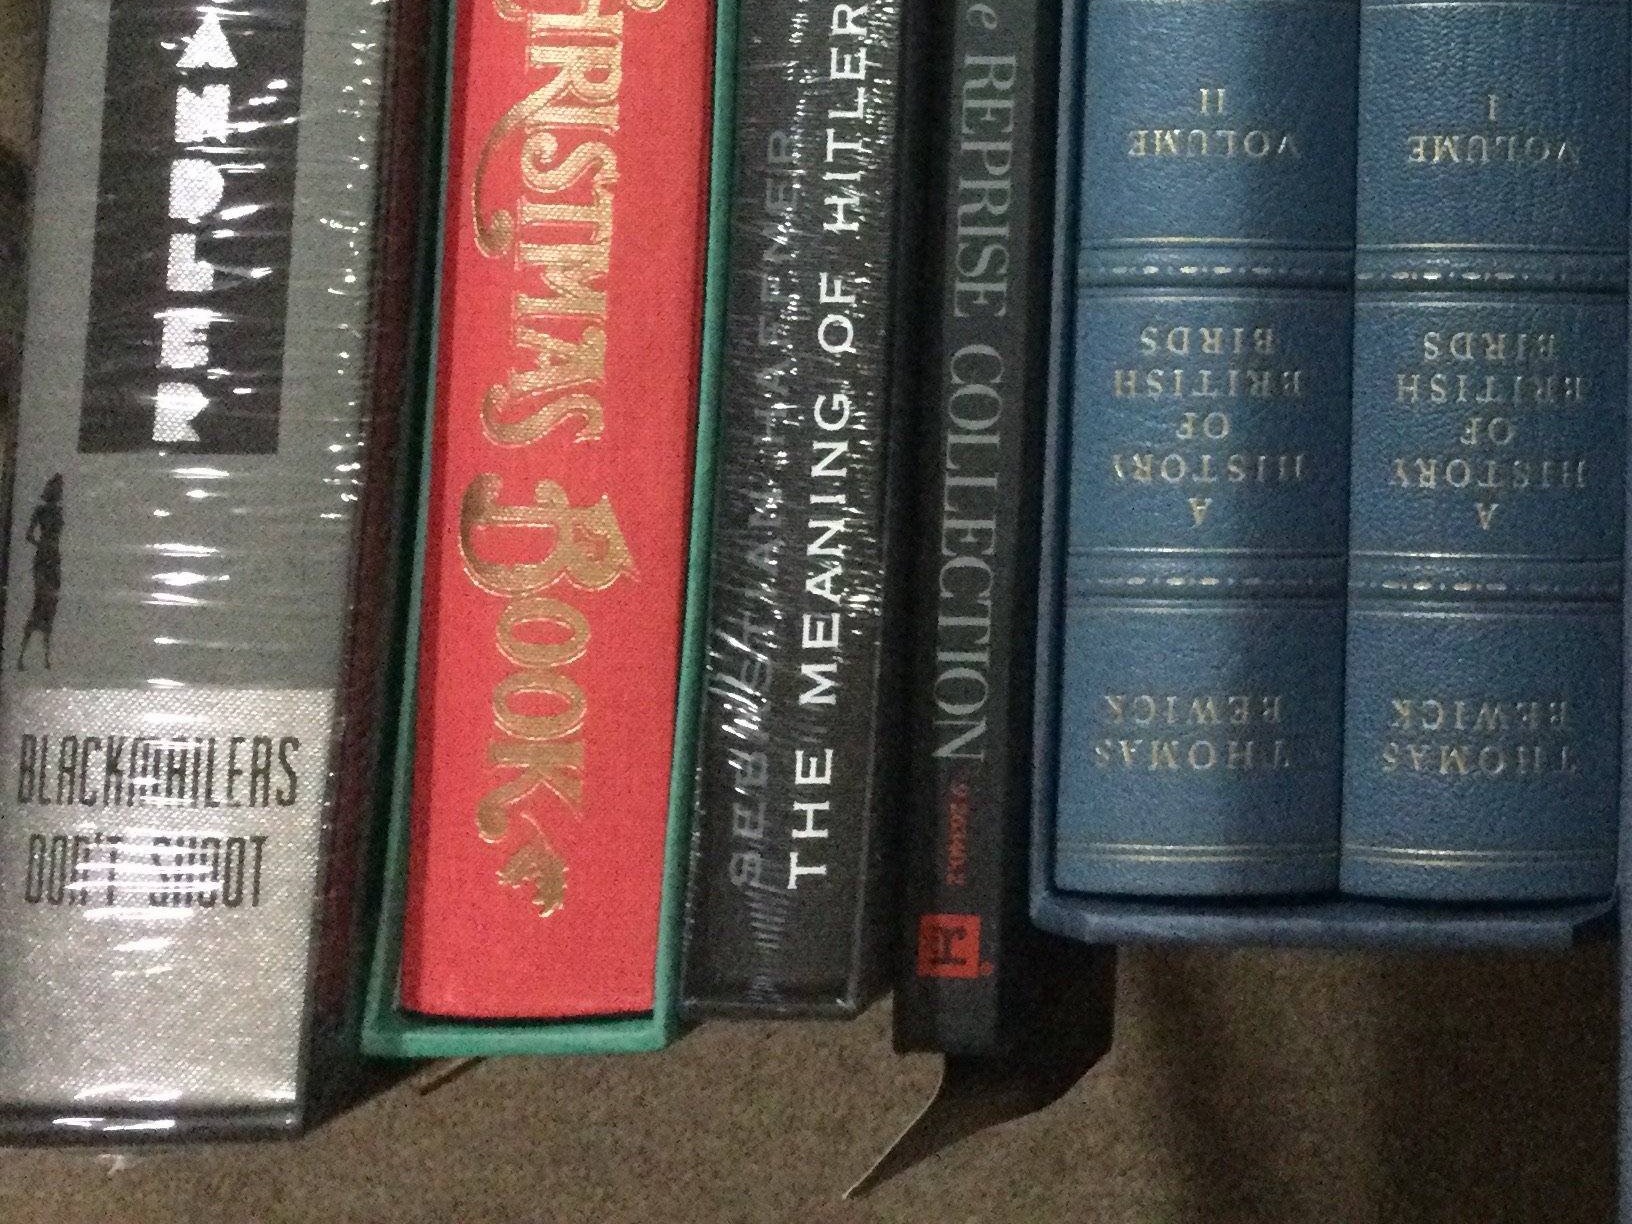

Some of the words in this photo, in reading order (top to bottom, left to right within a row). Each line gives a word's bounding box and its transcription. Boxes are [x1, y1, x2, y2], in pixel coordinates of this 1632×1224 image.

[1199, 88, 1227, 114] II
[1487, 93, 1499, 121] I
[822, 2, 869, 233] HITLER
[1127, 129, 1300, 158] VOLUME
[1407, 134, 1582, 164] VOLUME
[952, 54, 1017, 320] REPRISE
[817, 271, 858, 355] OF
[1141, 326, 1275, 355] BIRDS
[1423, 332, 1556, 361] BIRDS
[1113, 368, 1302, 398] BRITISH
[1396, 374, 1584, 404] BRITISH
[1175, 411, 1232, 440] OF
[1459, 417, 1516, 446] OF
[1112, 453, 1306, 483] HISTORY
[1392, 458, 1586, 489] HISTORY
[1188, 497, 1213, 527] A
[1473, 501, 1499, 531] A
[800, 392, 853, 706] MEANING
[931, 344, 1002, 764] COLLECTION
[459, 472, 640, 844] BOOK
[1104, 695, 1283, 725] BEWICK
[1391, 698, 1569, 730] BEWICK
[17, 733, 300, 807] BLACKMAILERS
[1095, 739, 1290, 771] THOMAS
[1381, 743, 1578, 775] THOMAS
[788, 747, 835, 889] THE
[149, 835, 269, 908] SHOOT
